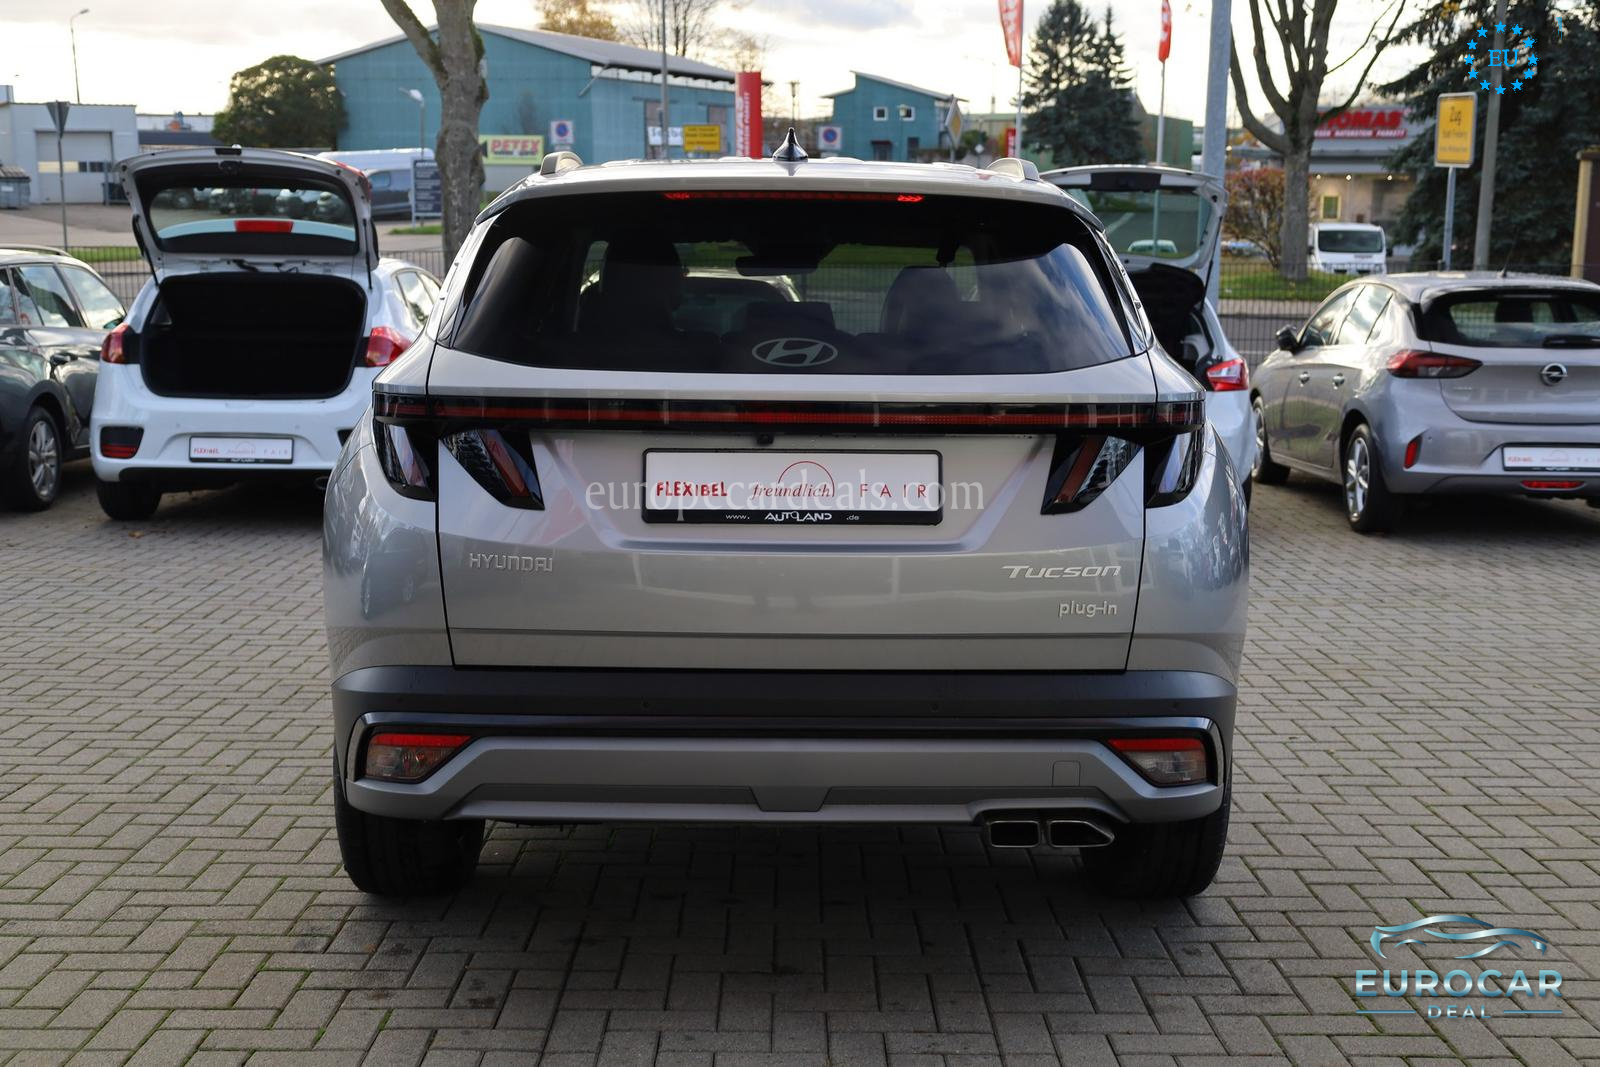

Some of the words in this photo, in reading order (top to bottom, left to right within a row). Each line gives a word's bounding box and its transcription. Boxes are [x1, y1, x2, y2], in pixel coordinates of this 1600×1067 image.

[656, 481, 727, 497] FLEXIBEL
[752, 483, 831, 500] freundlich
[859, 483, 927, 498] FAIR
[469, 552, 553, 572] HYUNDAI
[1058, 600, 1118, 618] plug-in
